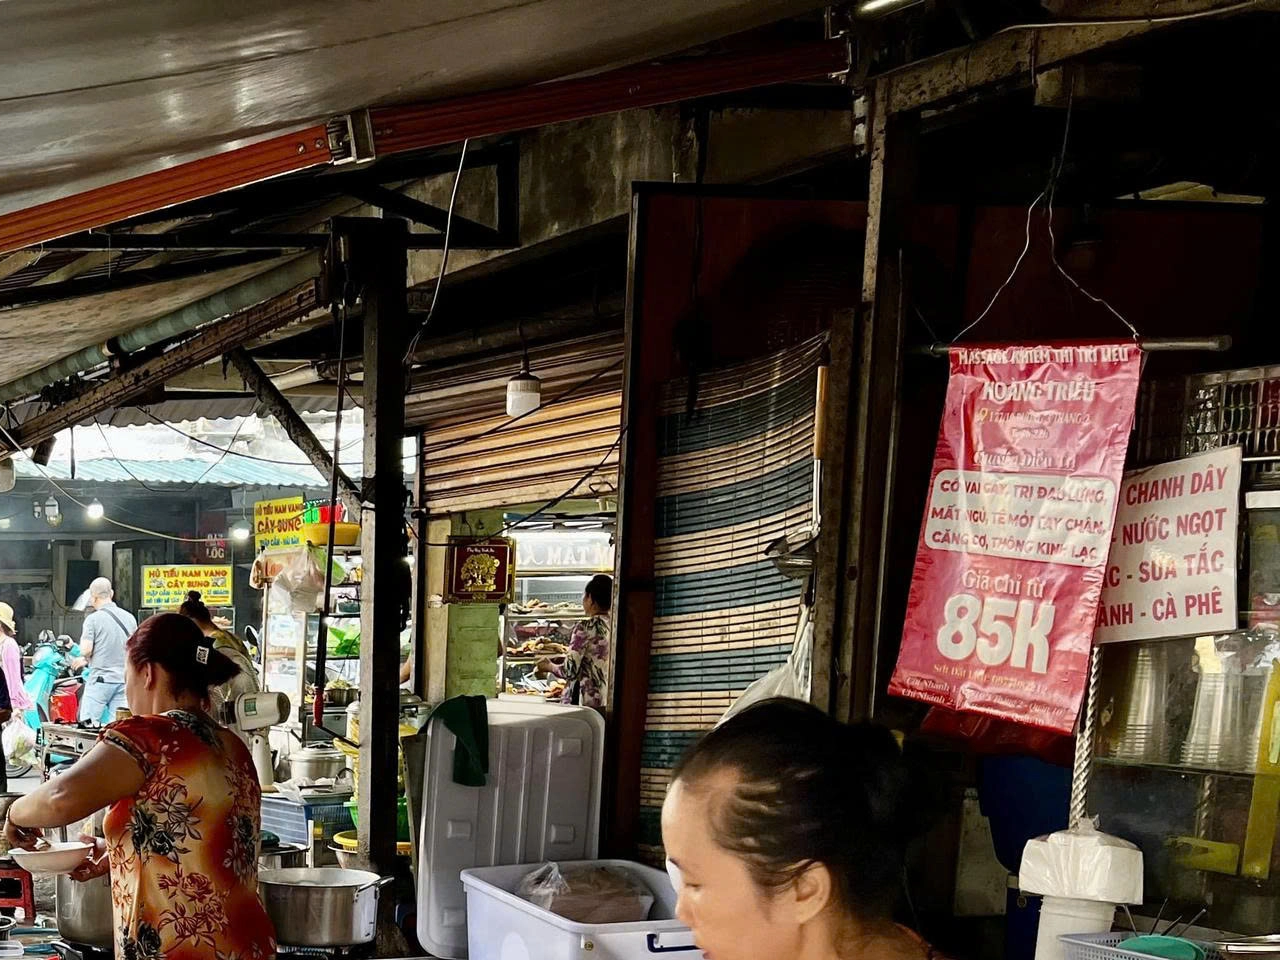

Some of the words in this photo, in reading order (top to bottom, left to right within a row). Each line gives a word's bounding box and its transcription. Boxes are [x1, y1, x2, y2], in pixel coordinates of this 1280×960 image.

[965, 481, 980, 494] VAI
[1126, 474, 1185, 506] CHANH
[1190, 463, 1229, 495] DÂY
[932, 529, 969, 545] CĂNG
[1122, 513, 1170, 546] NƯỚC
[1176, 508, 1227, 538] NGỌT
[1184, 542, 1225, 577] TẮC
[962, 568, 990, 590] Giá
[994, 573, 1023, 596] chỉ
[1152, 592, 1178, 622] CÀ
[1184, 586, 1223, 618] PHÊ
[936, 592, 1056, 675] 85K
